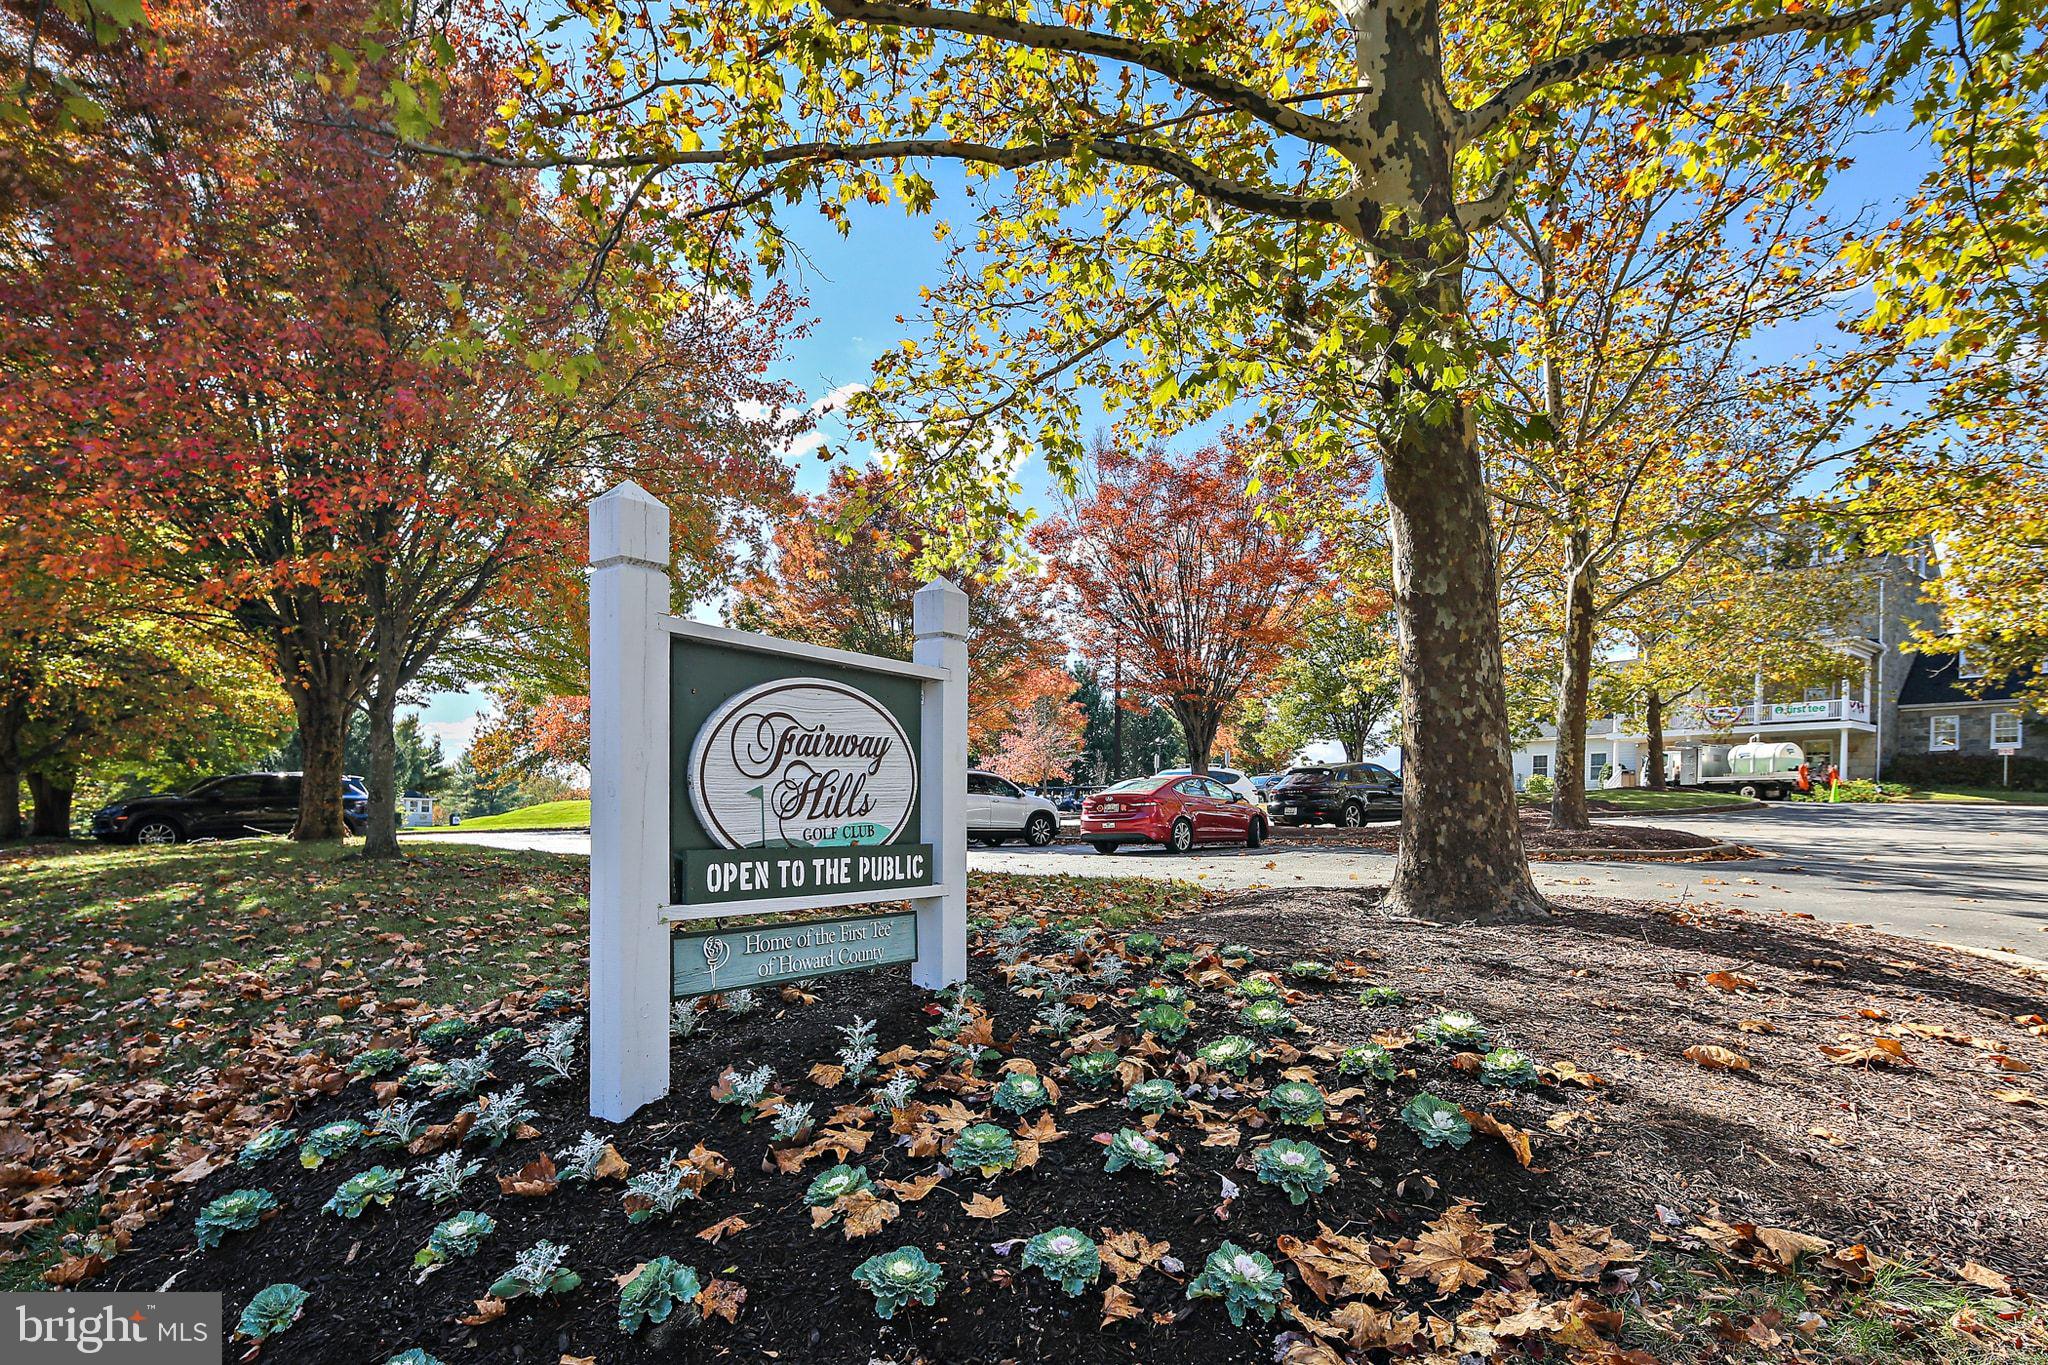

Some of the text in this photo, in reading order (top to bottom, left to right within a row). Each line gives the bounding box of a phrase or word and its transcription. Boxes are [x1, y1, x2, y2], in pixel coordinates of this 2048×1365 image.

[1808, 705, 1826, 713] tee
[731, 712, 893, 779] Fairway
[771, 760, 877, 821] Hills
[803, 825, 875, 841] GOLF CLUB
[706, 854, 924, 893] OPEN TO THE PUBLIC
[743, 933, 793, 954] Home
[797, 928, 813, 948] of
[816, 926, 836, 945] the
[839, 924, 867, 942] First
[758, 946, 885, 977] of Howard County
